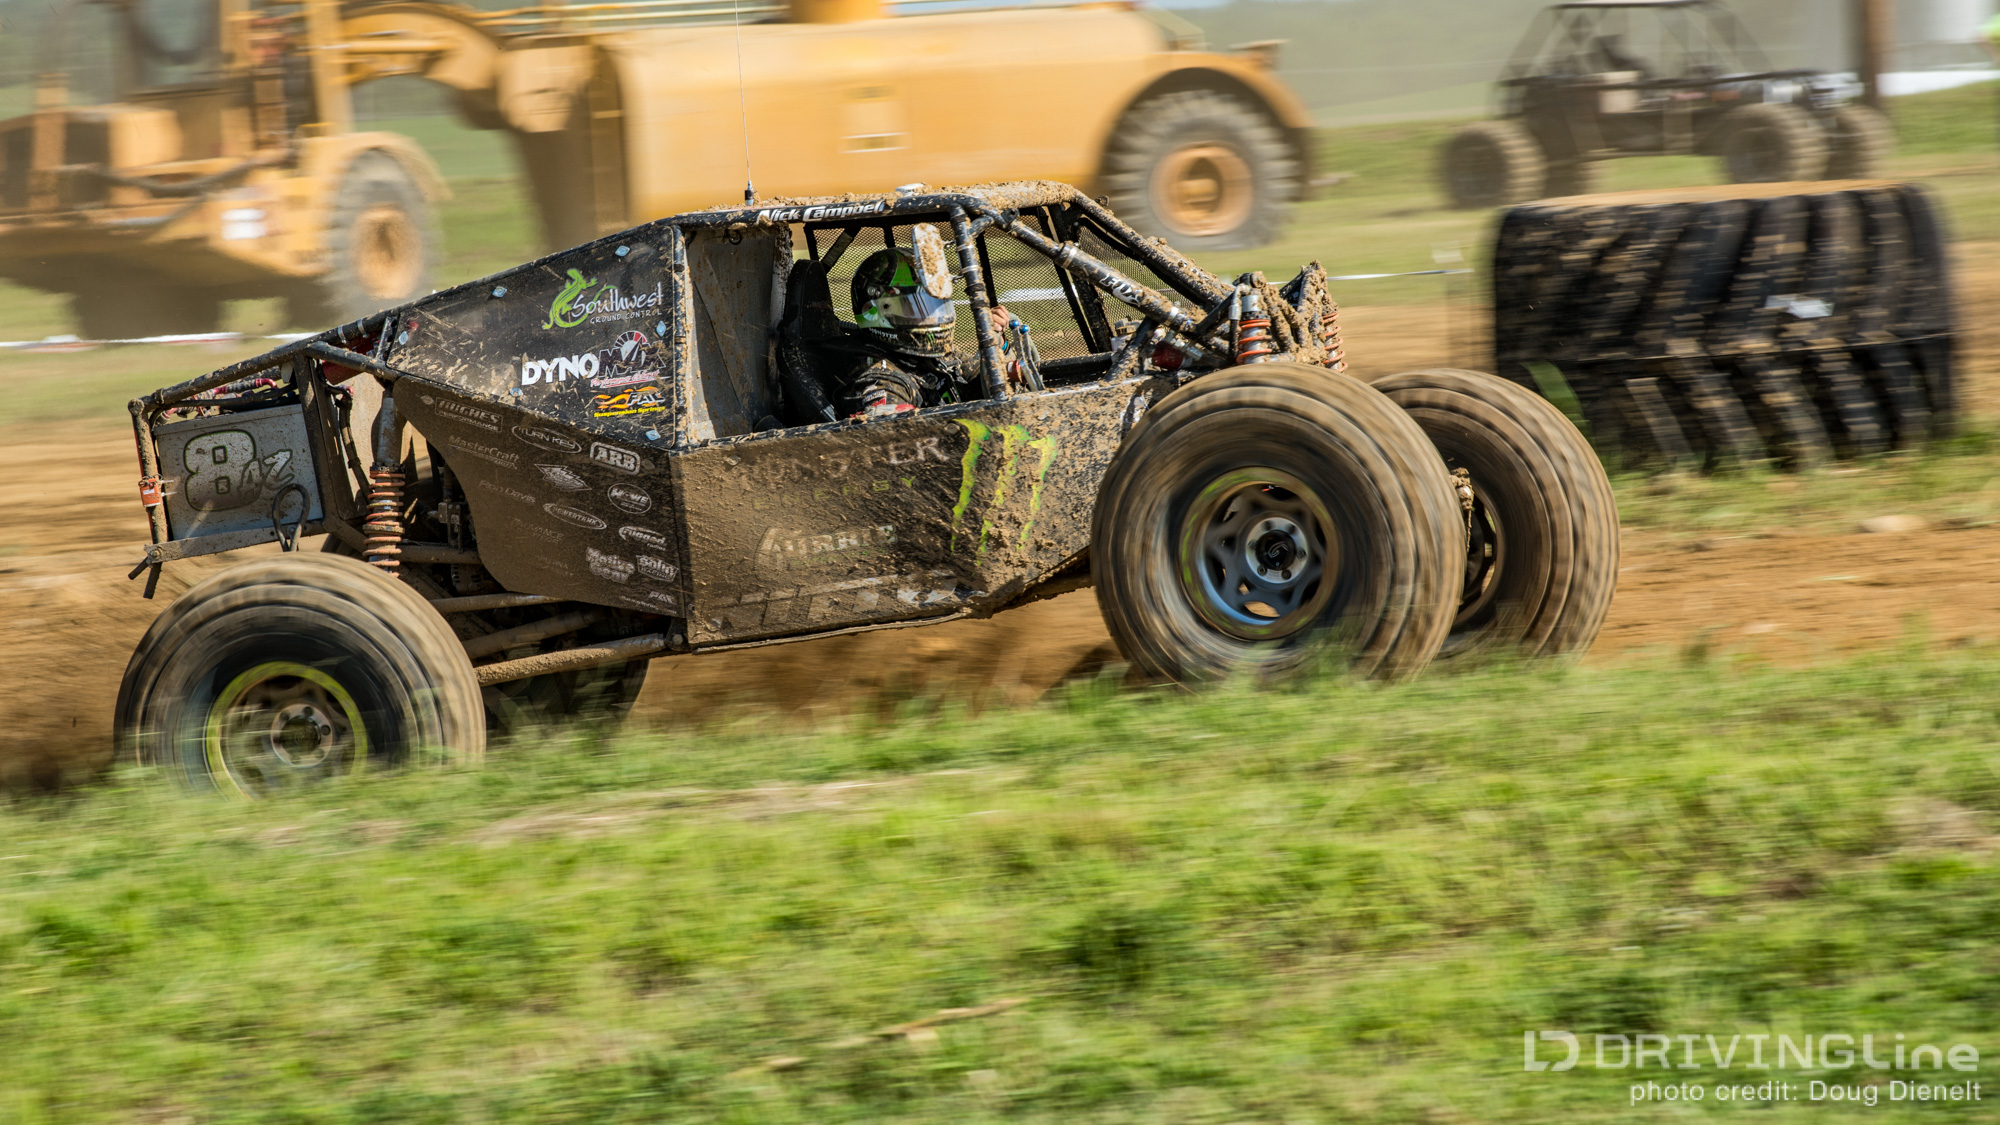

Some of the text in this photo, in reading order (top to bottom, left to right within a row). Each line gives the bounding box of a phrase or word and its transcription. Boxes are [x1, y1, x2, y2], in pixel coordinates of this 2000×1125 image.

[571, 281, 664, 318] Southwest
[590, 309, 662, 325] GROUND CONTROL
[595, 447, 636, 471] ARB
